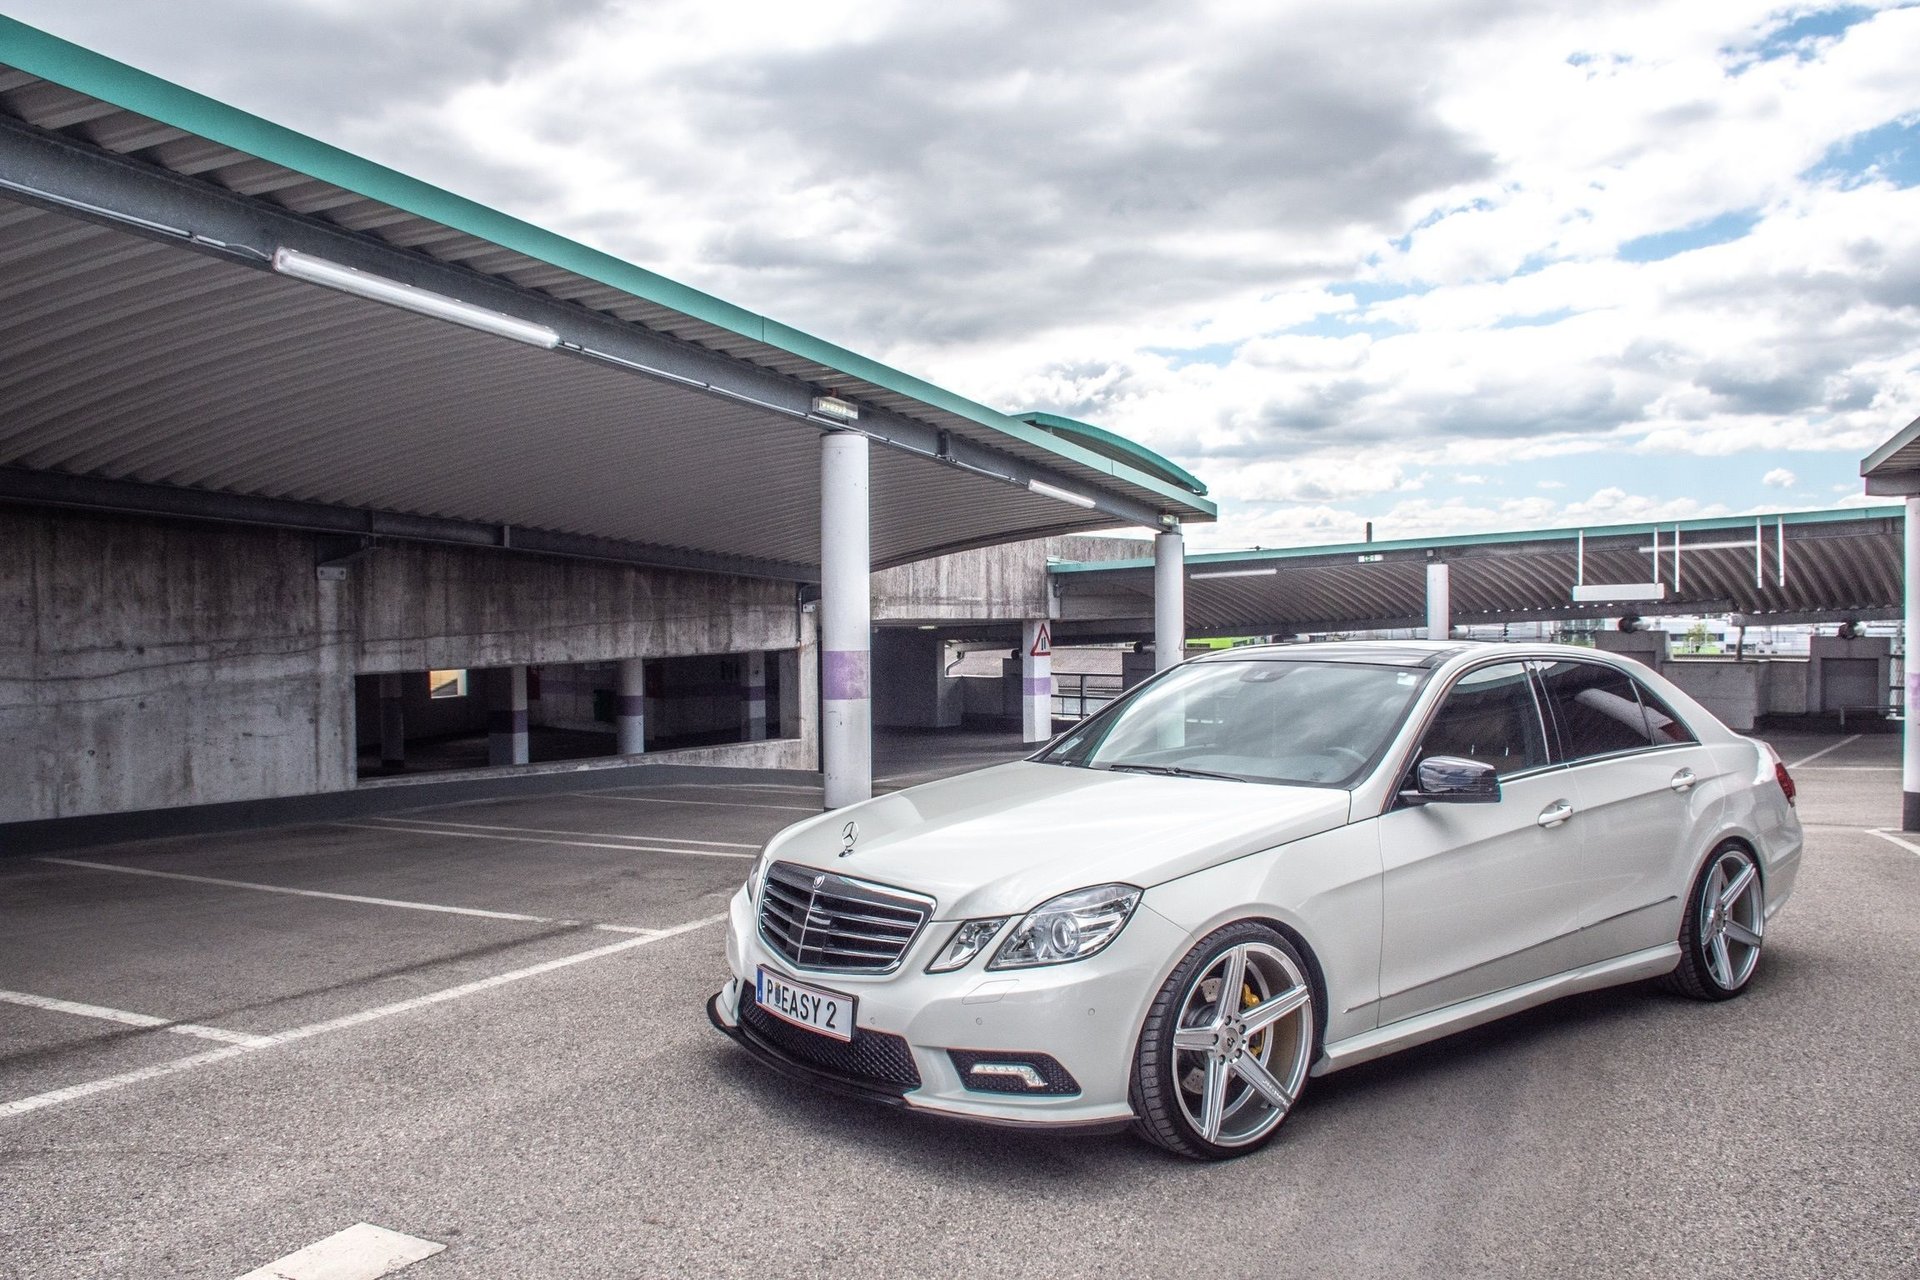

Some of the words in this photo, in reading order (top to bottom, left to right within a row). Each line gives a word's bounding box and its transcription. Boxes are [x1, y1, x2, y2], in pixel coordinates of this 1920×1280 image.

[767, 979, 773, 1003] P
[781, 986, 821, 1023] EASY
[826, 1001, 837, 1028] 2
